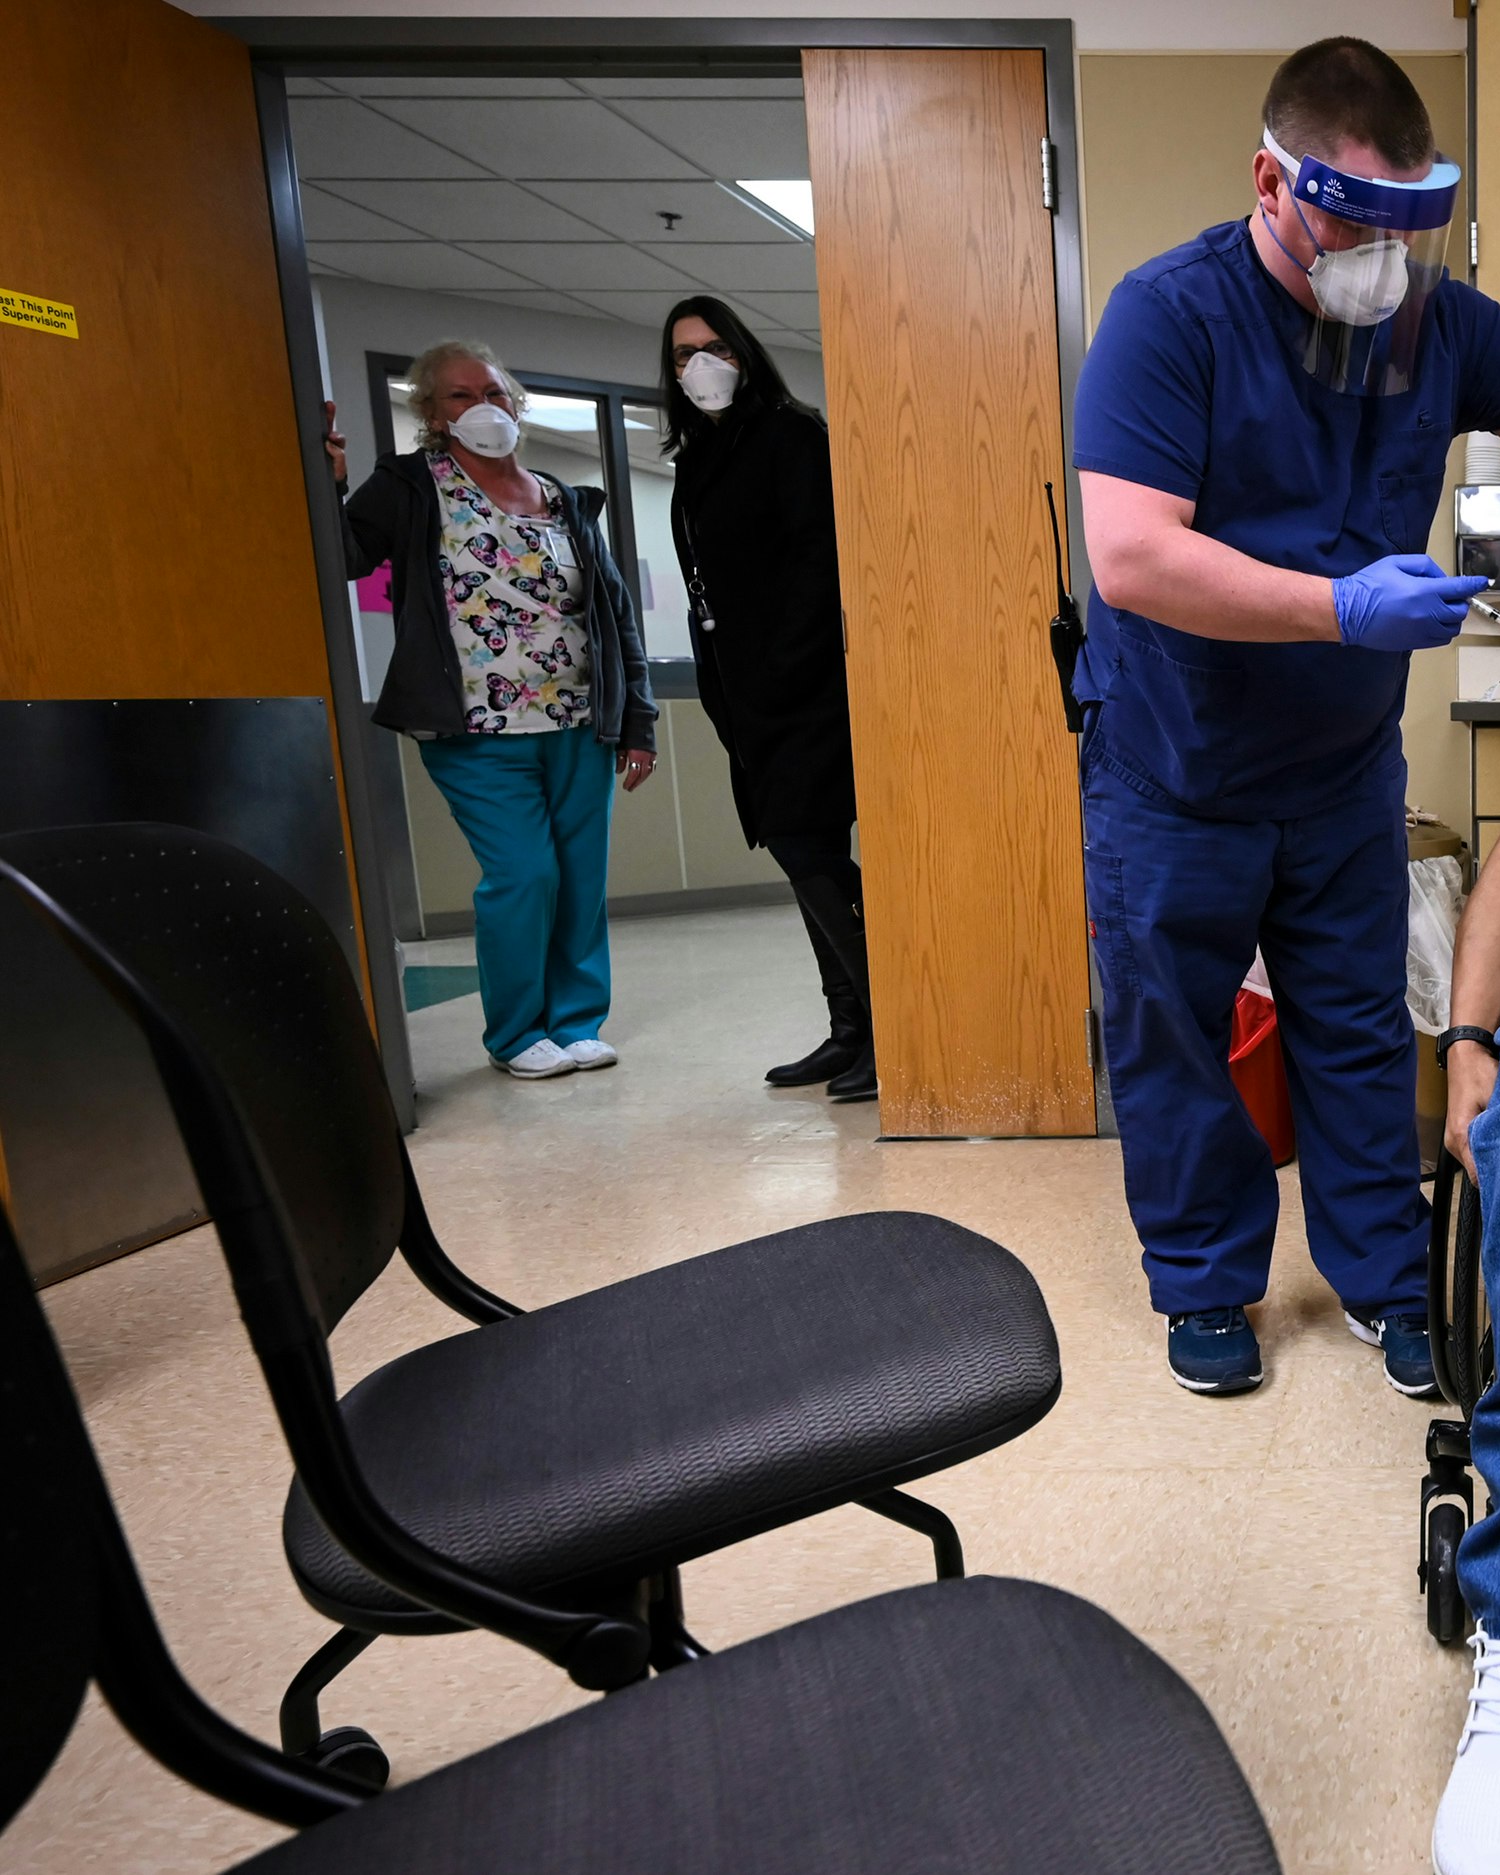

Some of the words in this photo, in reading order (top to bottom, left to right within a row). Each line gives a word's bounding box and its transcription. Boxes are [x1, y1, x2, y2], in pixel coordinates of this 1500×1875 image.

[1323, 185, 1345, 199] INTCO
[2, 306, 67, 329] Supervision
[20, 299, 43, 313] This
[47, 305, 74, 321] Point
